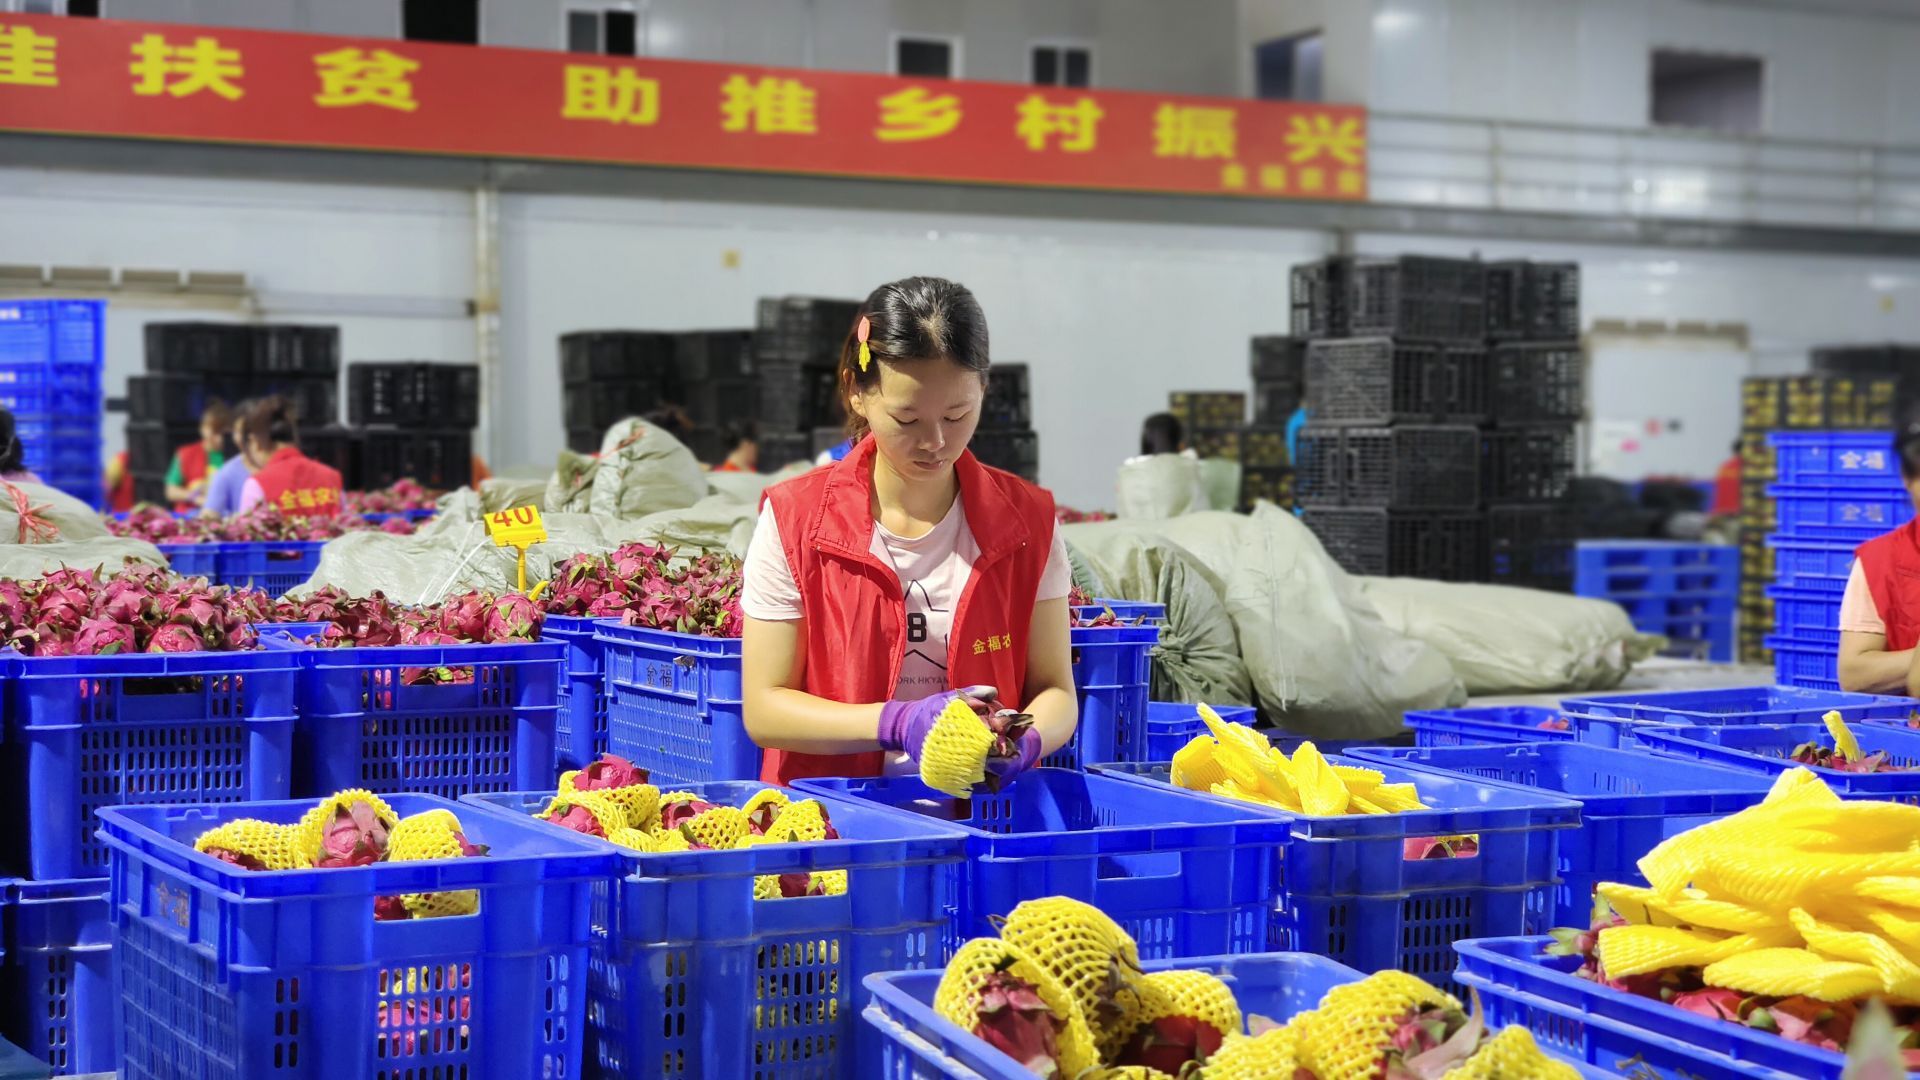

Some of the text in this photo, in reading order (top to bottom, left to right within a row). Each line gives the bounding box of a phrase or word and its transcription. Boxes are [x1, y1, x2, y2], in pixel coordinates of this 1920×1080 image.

[560, 63, 1366, 165] 助推乡村振兴
[493, 506, 533, 527] 40
[646, 664, 673, 688] 金福
